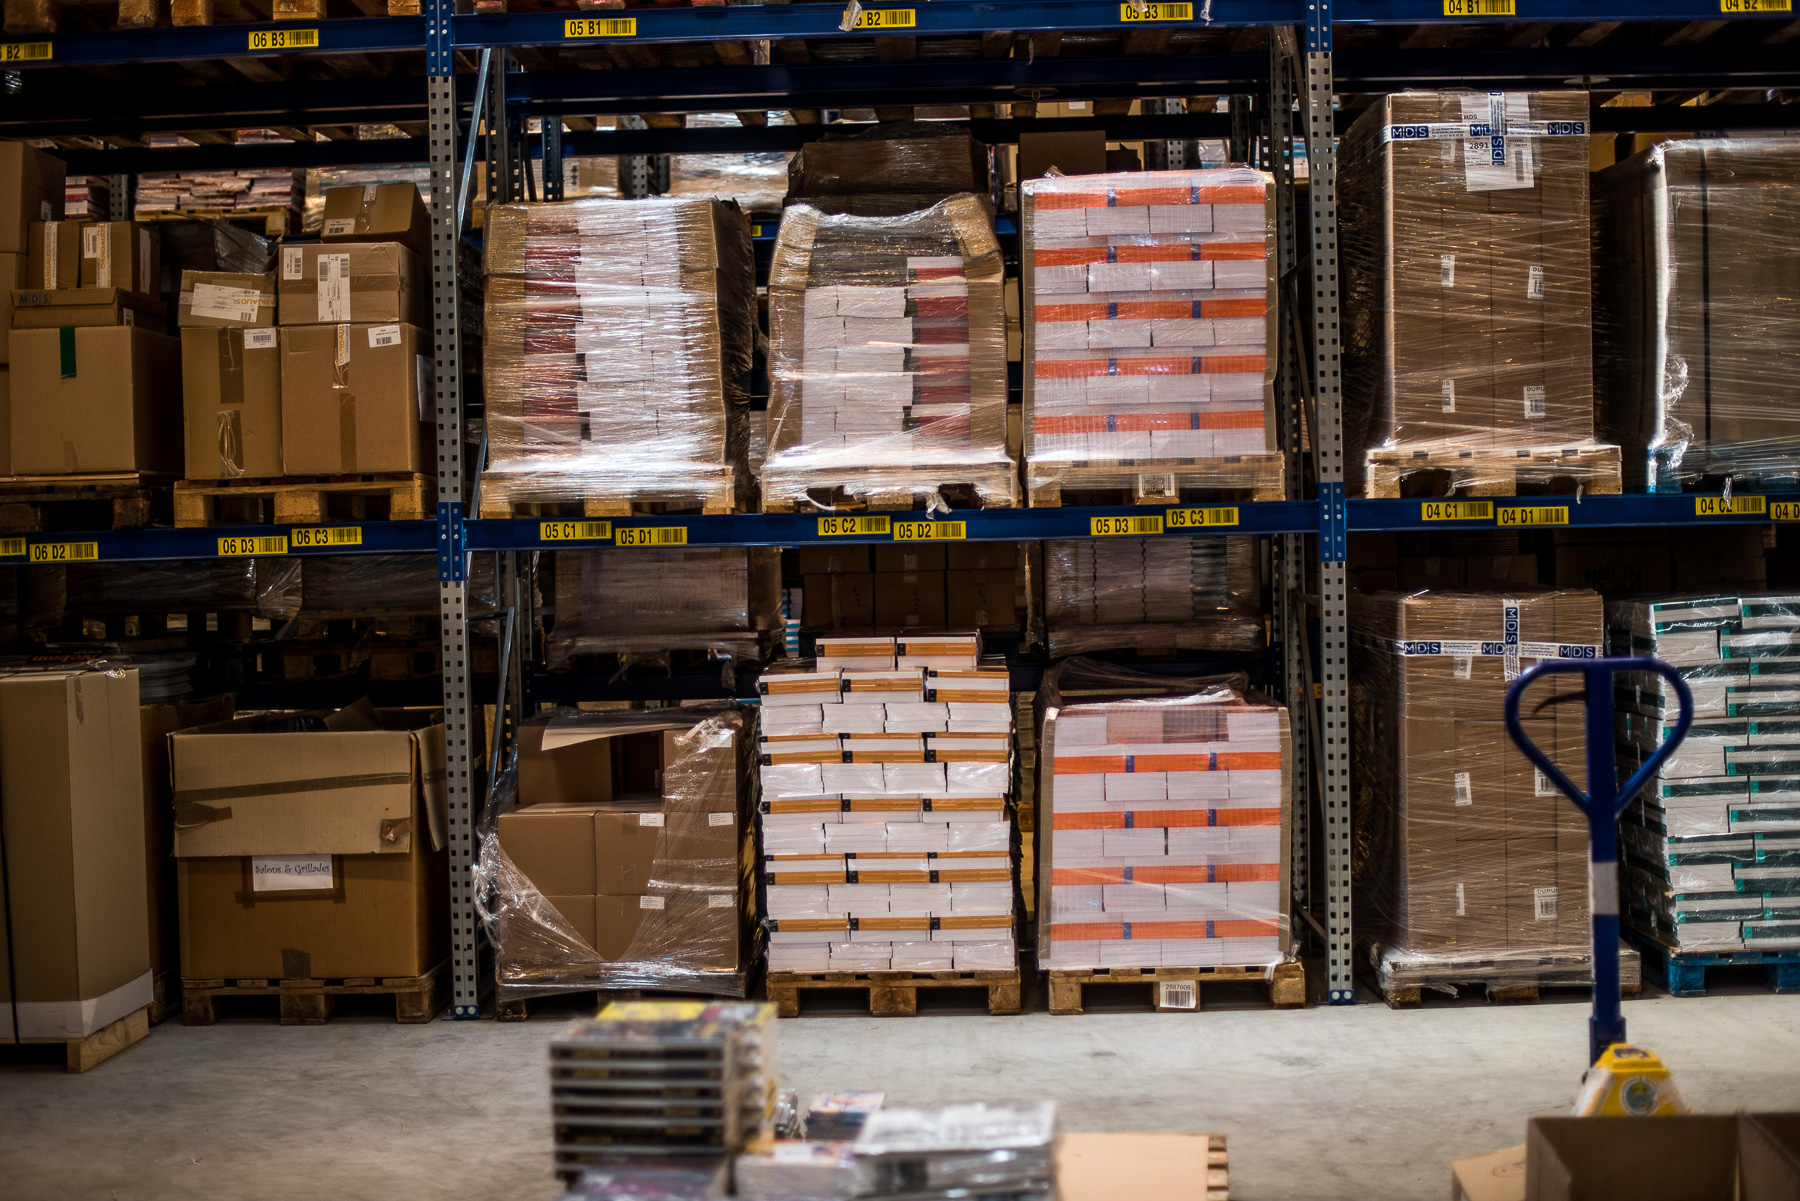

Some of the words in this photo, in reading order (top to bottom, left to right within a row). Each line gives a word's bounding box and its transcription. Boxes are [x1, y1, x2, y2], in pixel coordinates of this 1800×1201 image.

[1449, 0, 1462, 13] 04
[1467, 0, 1480, 13] B1
[1743, 0, 1757, 9] B2
[867, 11, 880, 26] B2
[569, 21, 584, 35] 05
[588, 20, 601, 35] B1
[253, 33, 267, 47] 06
[271, 32, 285, 46] B3
[6, 45, 20, 59] B2
[1392, 126, 1429, 139] MDS
[1547, 122, 1585, 135] MDS
[1469, 142, 1490, 150] 2891
[1426, 504, 1440, 518] 04
[1444, 503, 1458, 518] C1
[1701, 499, 1714, 513] 04
[1775, 504, 1789, 518] 04
[1171, 511, 1185, 525] 05
[1190, 510, 1204, 525] C3
[1502, 509, 1516, 523] 04
[1520, 508, 1534, 523] D1
[545, 524, 559, 538] 05
[563, 523, 576, 538] C1
[823, 519, 837, 533] 05
[842, 518, 856, 533] C2
[898, 524, 912, 538] 05
[917, 523, 931, 538] D2
[1096, 519, 1110, 533] 05
[1114, 518, 1128, 533] D3
[296, 530, 310, 545] 06
[314, 529, 328, 544] C3
[621, 530, 634, 544] 05
[639, 529, 652, 543] D1
[34, 545, 47, 560] 06
[52, 544, 65, 559] D2
[223, 539, 237, 554] 06
[241, 538, 254, 553] D3
[1506, 607, 1518, 643] MDS
[1404, 643, 1440, 655] MDS
[1559, 646, 1596, 658] MDS
[255, 864, 281, 875] Salons
[284, 864, 292, 874] &
[294, 863, 331, 875] Grillades
